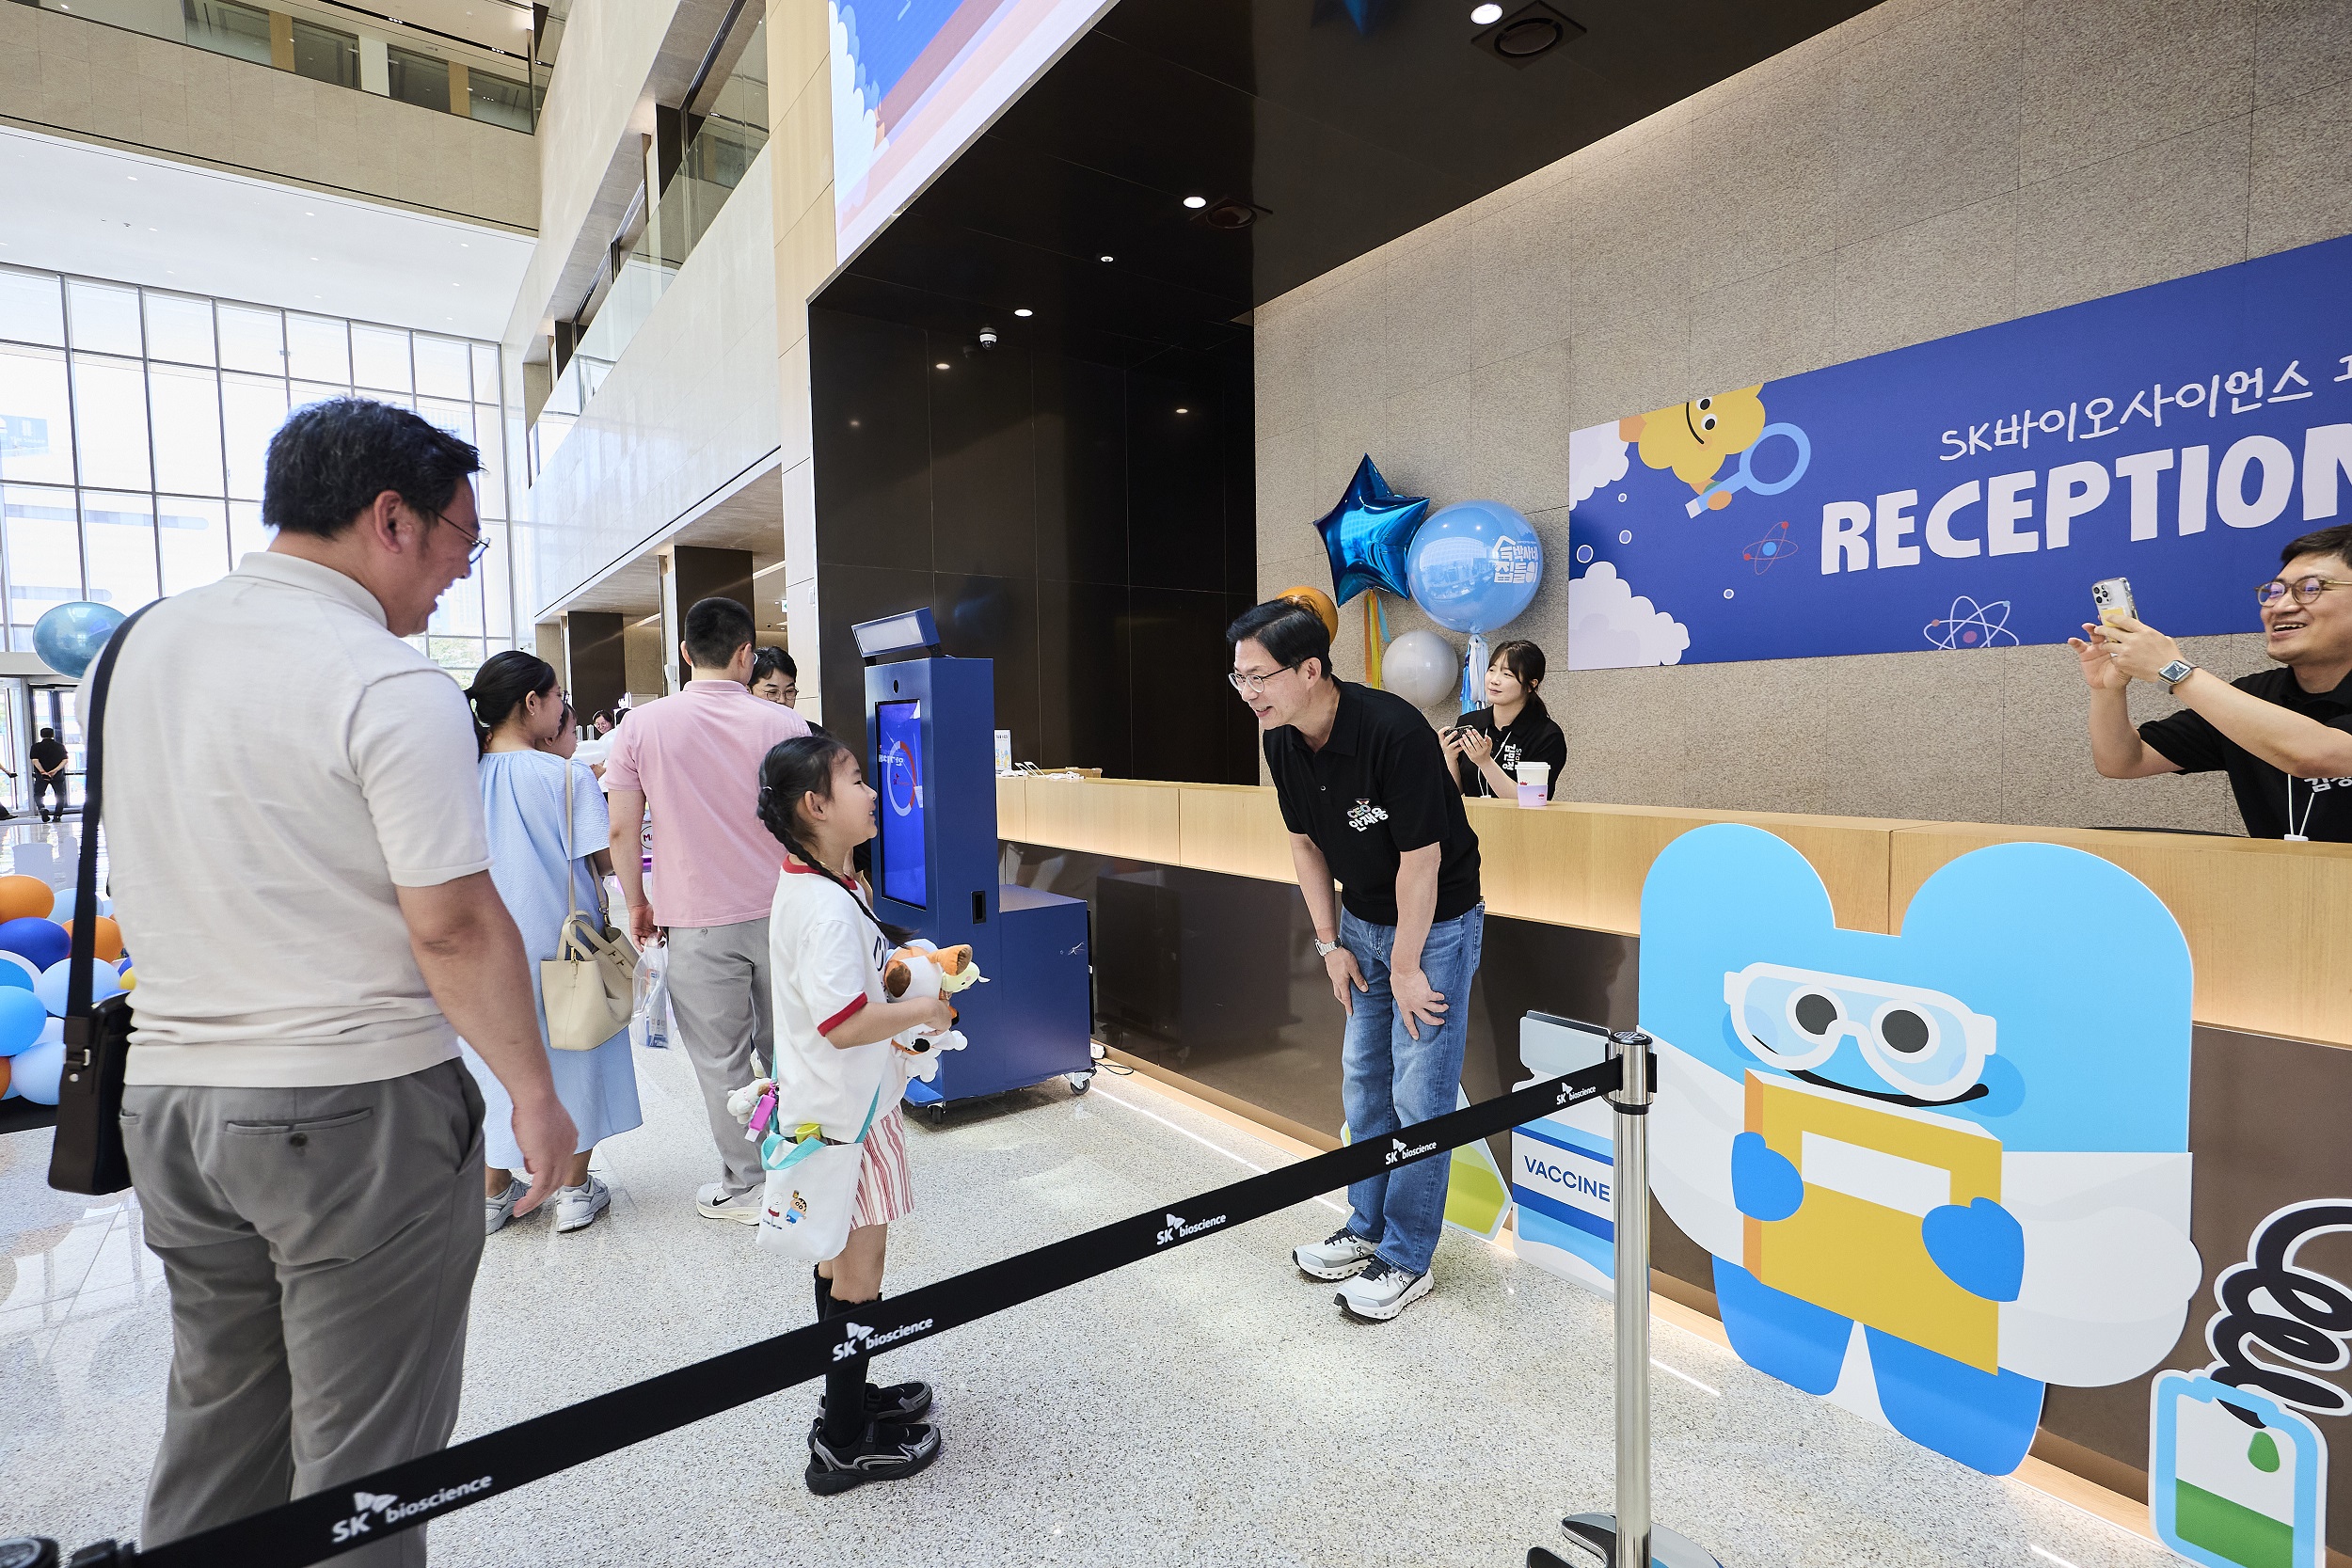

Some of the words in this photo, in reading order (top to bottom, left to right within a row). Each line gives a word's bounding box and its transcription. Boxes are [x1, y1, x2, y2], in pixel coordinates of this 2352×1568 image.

[1939, 360, 2313, 460] SK바이오사이언스
[1347, 805, 1371, 818] CEO
[1349, 808, 1389, 832] 안재용
[1556, 1092, 1566, 1105] SK
[1568, 1085, 1597, 1101] bioscience
[1385, 1150, 1398, 1165] SK
[1402, 1141, 1437, 1160] bioscience
[1523, 1154, 1611, 1203] VACCINE
[1156, 1227, 1174, 1245] SK
[1179, 1214, 1227, 1238] bioscience
[832, 1338, 858, 1362] SK
[866, 1318, 934, 1351] bioscience
[332, 1512, 372, 1544] SK
[385, 1475, 494, 1524] bioscience
